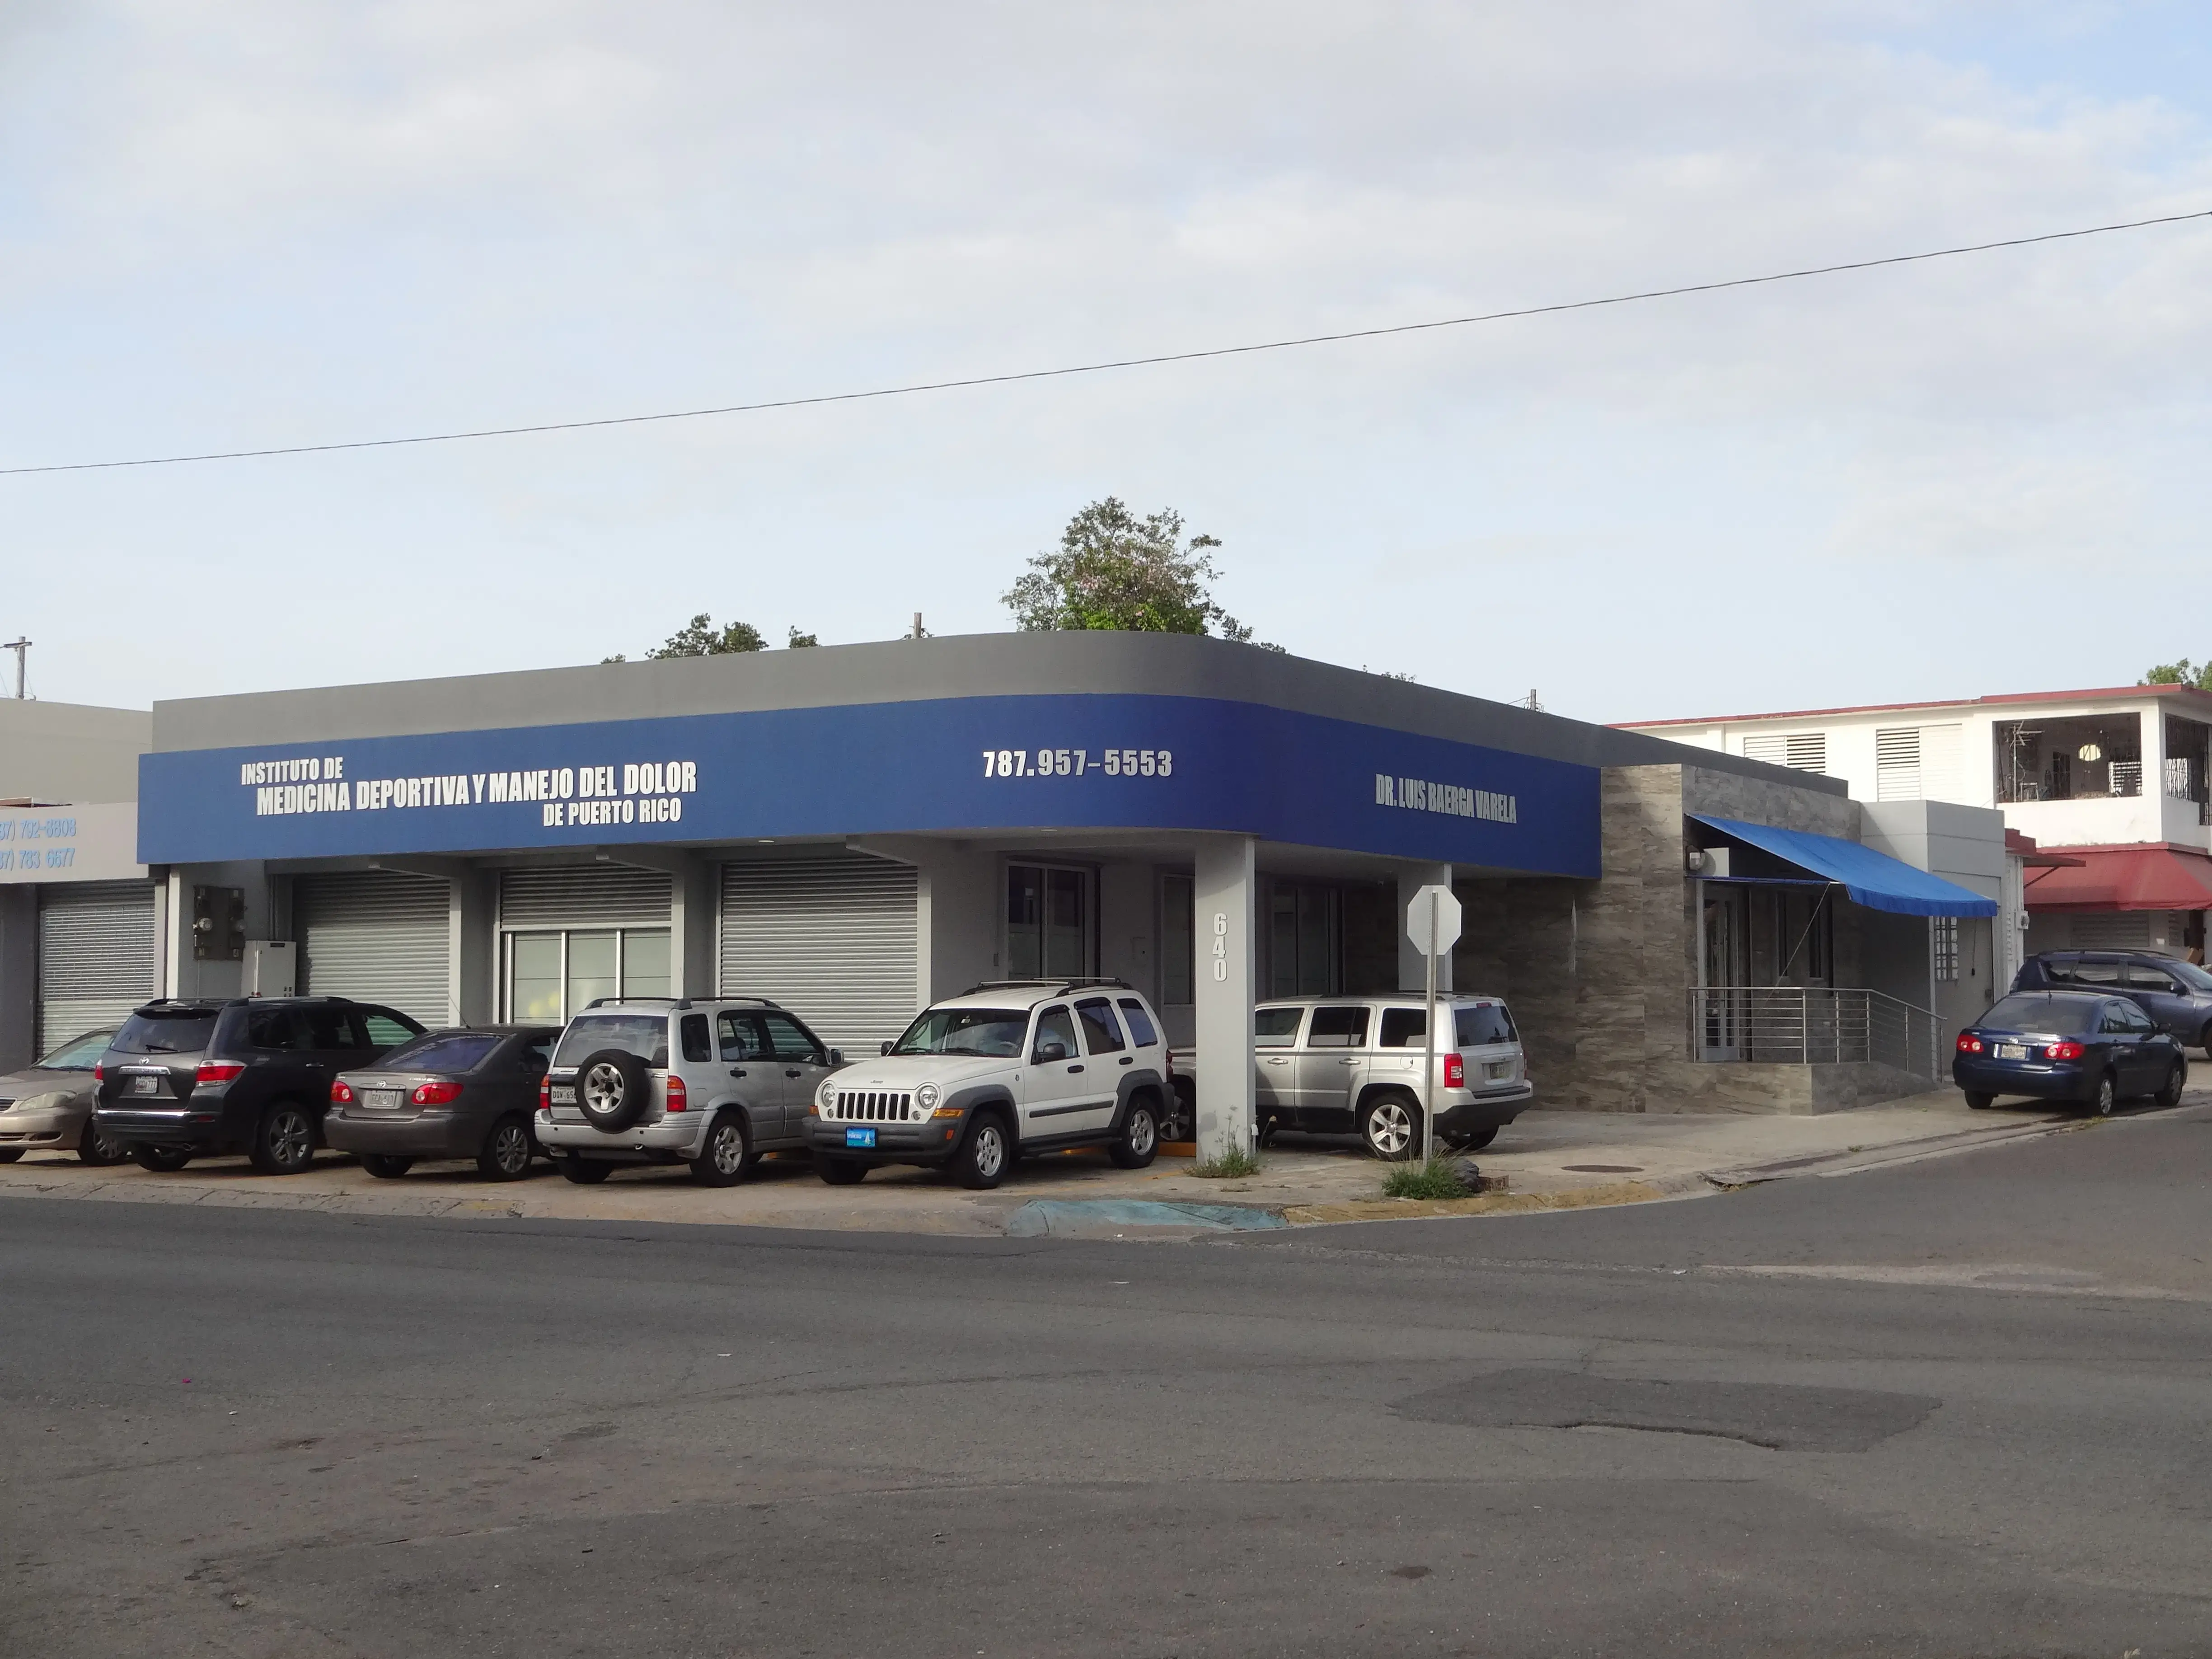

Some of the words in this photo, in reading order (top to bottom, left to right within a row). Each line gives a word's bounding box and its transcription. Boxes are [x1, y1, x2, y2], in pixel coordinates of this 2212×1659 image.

[241, 758, 320, 786] INSTITUTO
[323, 757, 344, 779] DE
[983, 749, 1172, 777] 787.957-5553
[257, 782, 351, 815] MEDICINA
[356, 775, 470, 810] DEPORTIVA
[472, 773, 487, 804] Y
[489, 768, 574, 803] MANEJO
[579, 765, 618, 797] DEL
[623, 761, 698, 795] DOLOR
[1375, 773, 1397, 806] DR.
[1398, 777, 1426, 811] LUIS
[1427, 782, 1475, 818] BAERGA
[1475, 789, 1517, 824] VARELA
[543, 803, 565, 827] DE
[568, 799, 634, 826] PUERTO
[638, 797, 682, 823] RICO
[20, 818, 76, 839] 792-8808
[19, 849, 41, 869] 783
[46, 847, 75, 868] 6677
[1212, 913, 1228, 982] 640
